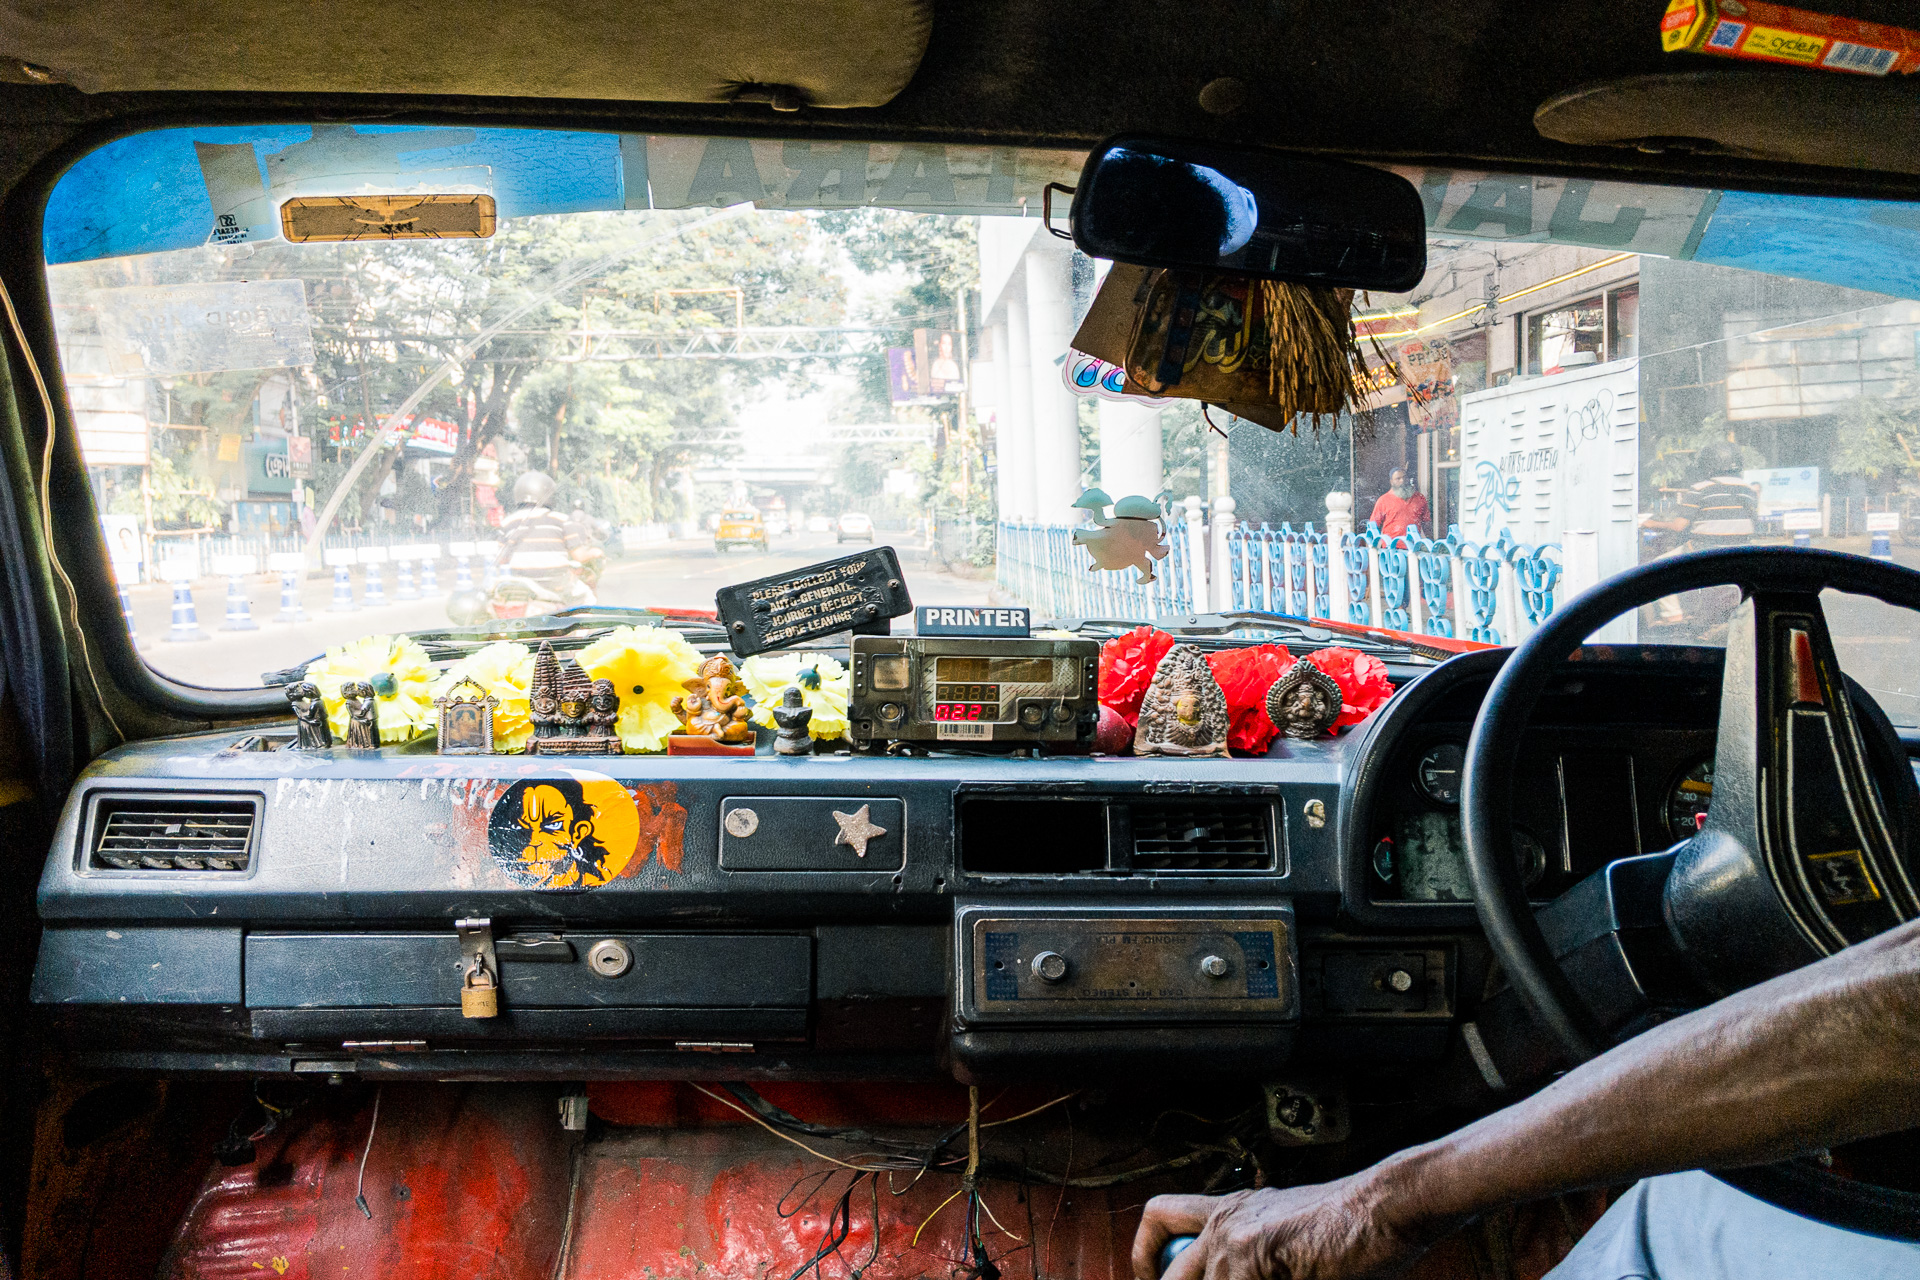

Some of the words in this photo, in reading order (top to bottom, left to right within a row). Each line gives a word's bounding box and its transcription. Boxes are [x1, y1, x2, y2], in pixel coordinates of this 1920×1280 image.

[752, 584, 790, 601] PLEASE
[793, 570, 837, 590] COLLECT
[772, 605, 818, 627] JOURNEY
[926, 608, 1026, 627] PRINTER
[764, 623, 807, 643] BEFORE
[1684, 793, 1697, 801] 40
[1681, 817, 1696, 827] 20
[1082, 988, 1130, 997] STEREO
